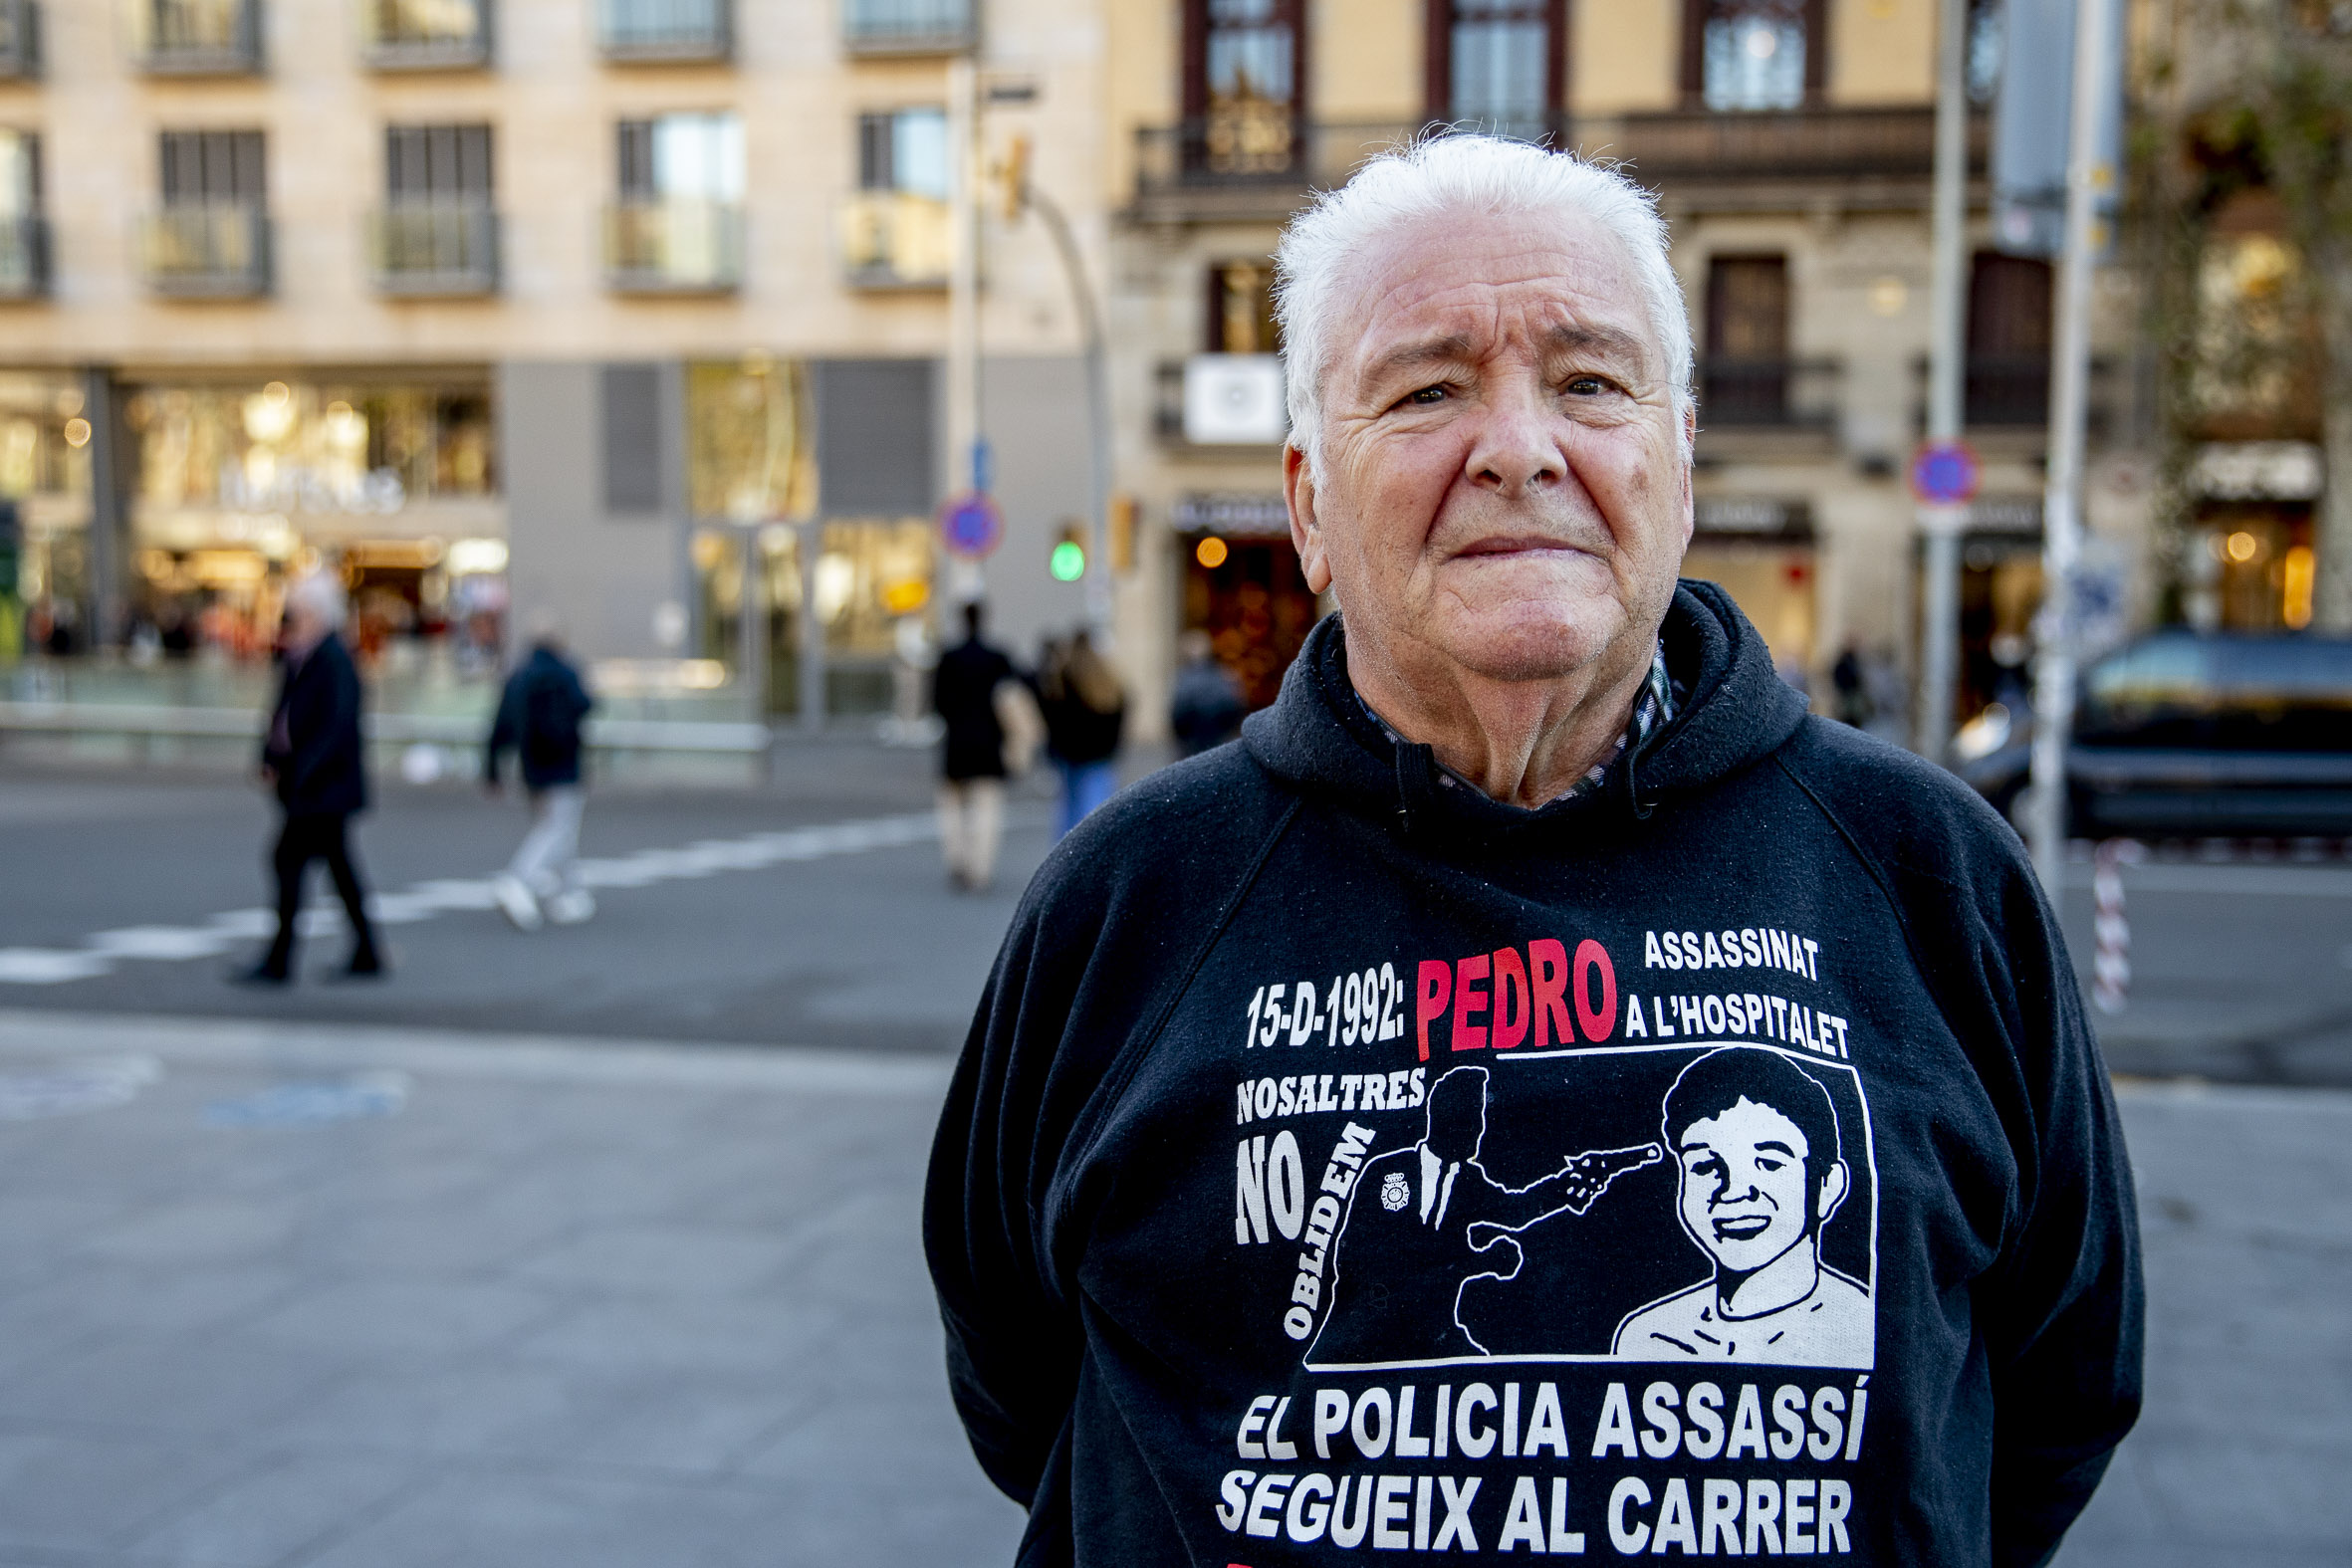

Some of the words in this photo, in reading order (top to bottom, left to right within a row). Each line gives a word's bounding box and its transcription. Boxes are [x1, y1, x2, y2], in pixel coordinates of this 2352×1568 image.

[1644, 928, 1819, 982] ASSASSINAT
[1246, 962, 1404, 1049] 15-D-1992:
[1416, 938, 1617, 1061] PEDRO
[1625, 994, 1648, 1038] A
[1654, 994, 1850, 1060] L'HOSPITALET
[1237, 1066, 1427, 1125] NOSALTRES
[1235, 1129, 1305, 1245] NO
[1284, 1121, 1377, 1342] OBLIDEM
[1237, 1395, 1298, 1460] EL
[1313, 1382, 1570, 1460] POLICIA
[1590, 1374, 1871, 1461] ASSASSÍ
[1215, 1469, 1483, 1553] SEGUEIX
[1498, 1475, 1586, 1555] AL
[1607, 1475, 1853, 1557] CARRER
